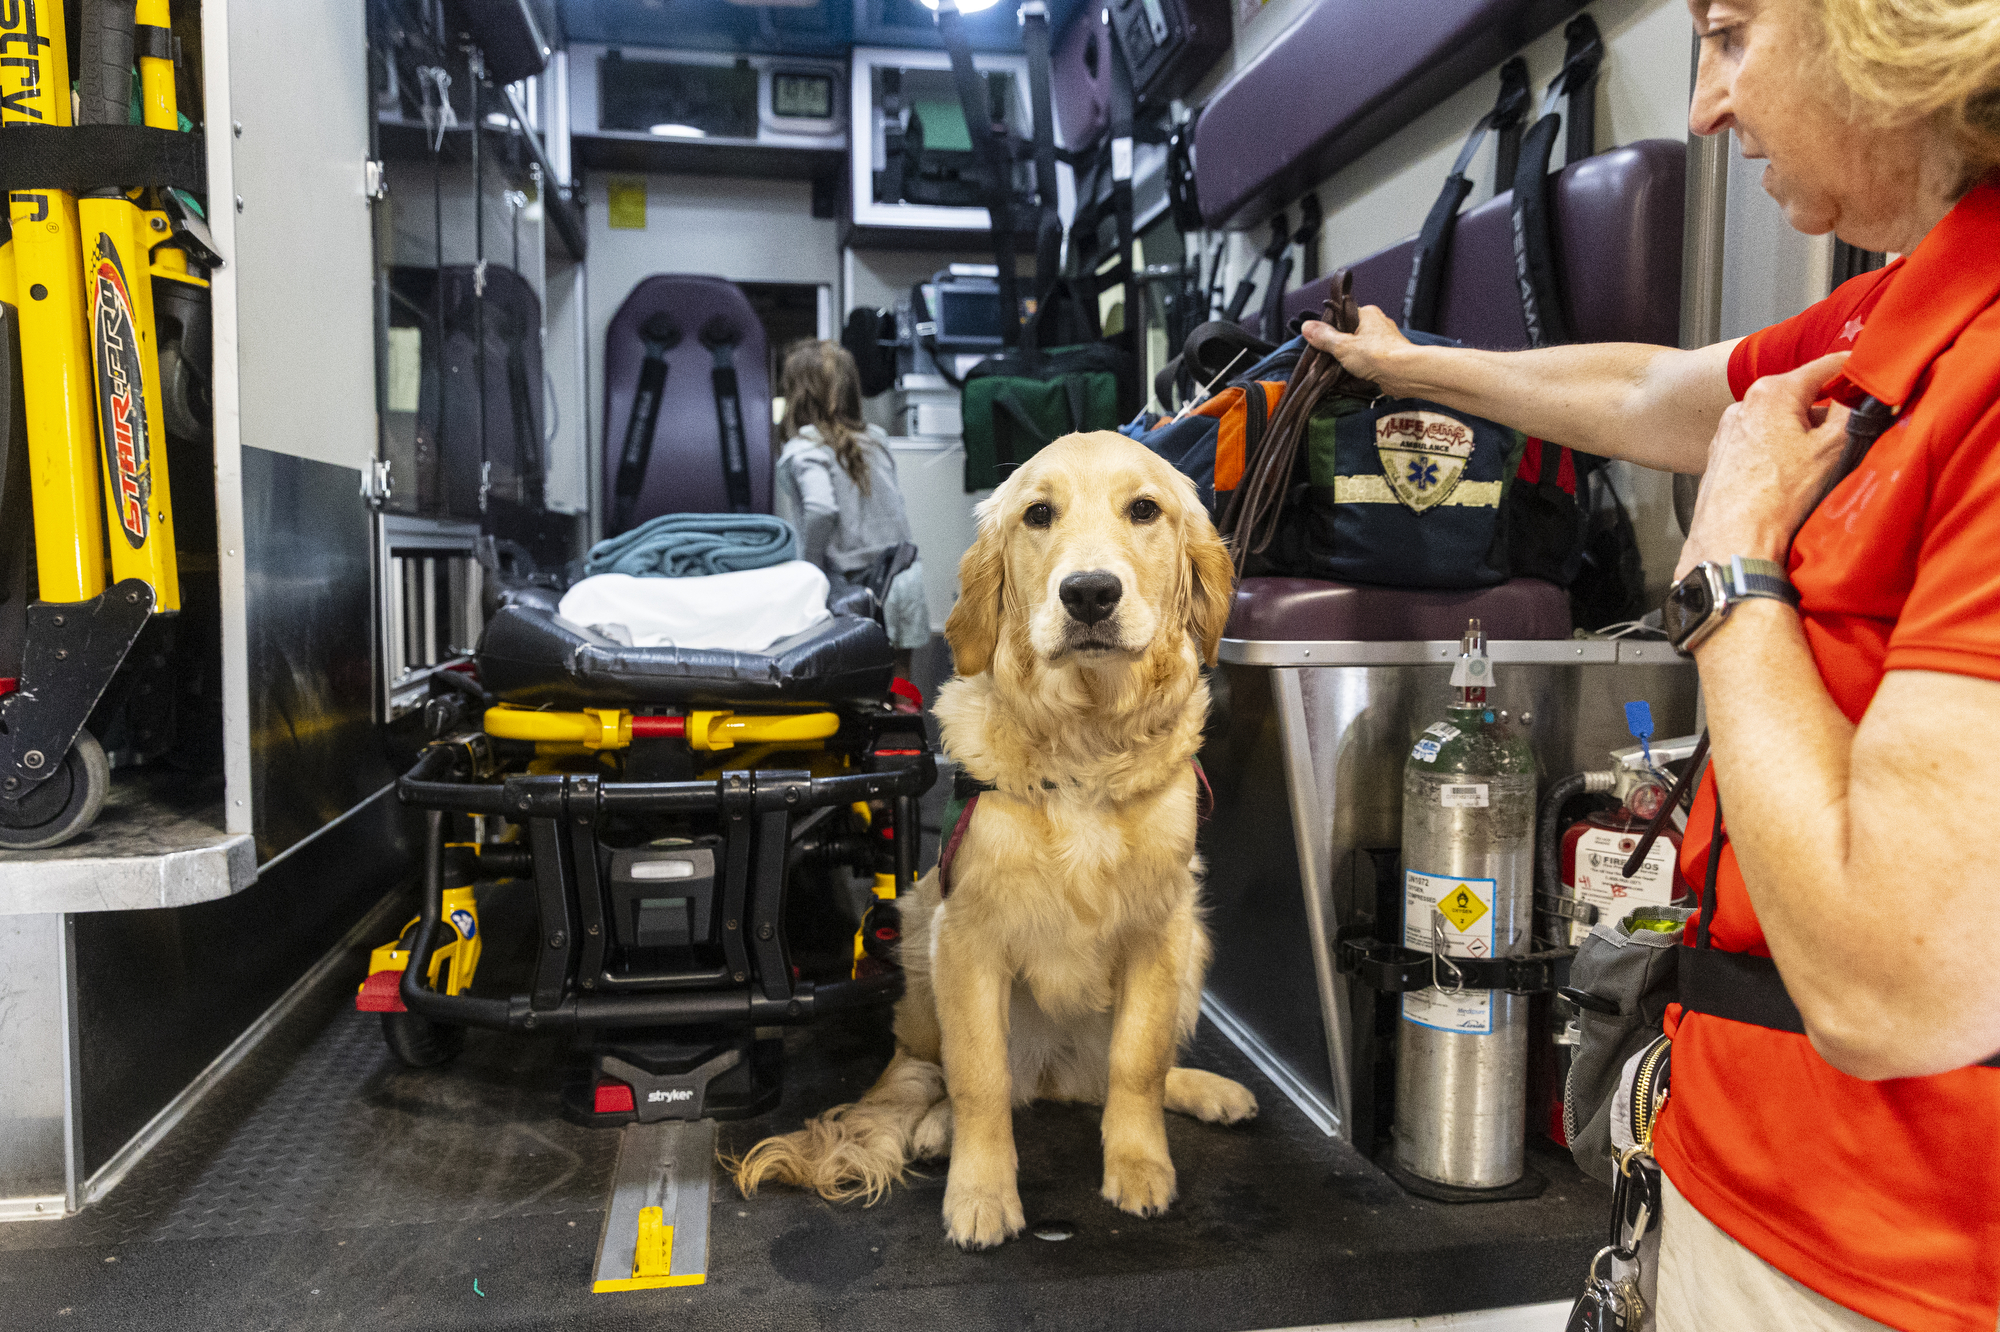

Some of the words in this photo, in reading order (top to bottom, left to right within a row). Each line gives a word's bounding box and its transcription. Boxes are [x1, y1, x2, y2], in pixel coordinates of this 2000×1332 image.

[0, 0, 50, 222] stryr
[1390, 417, 1424, 433] LIFE
[1400, 440, 1450, 452] AMBULANCE
[647, 1088, 693, 1103] stryker
